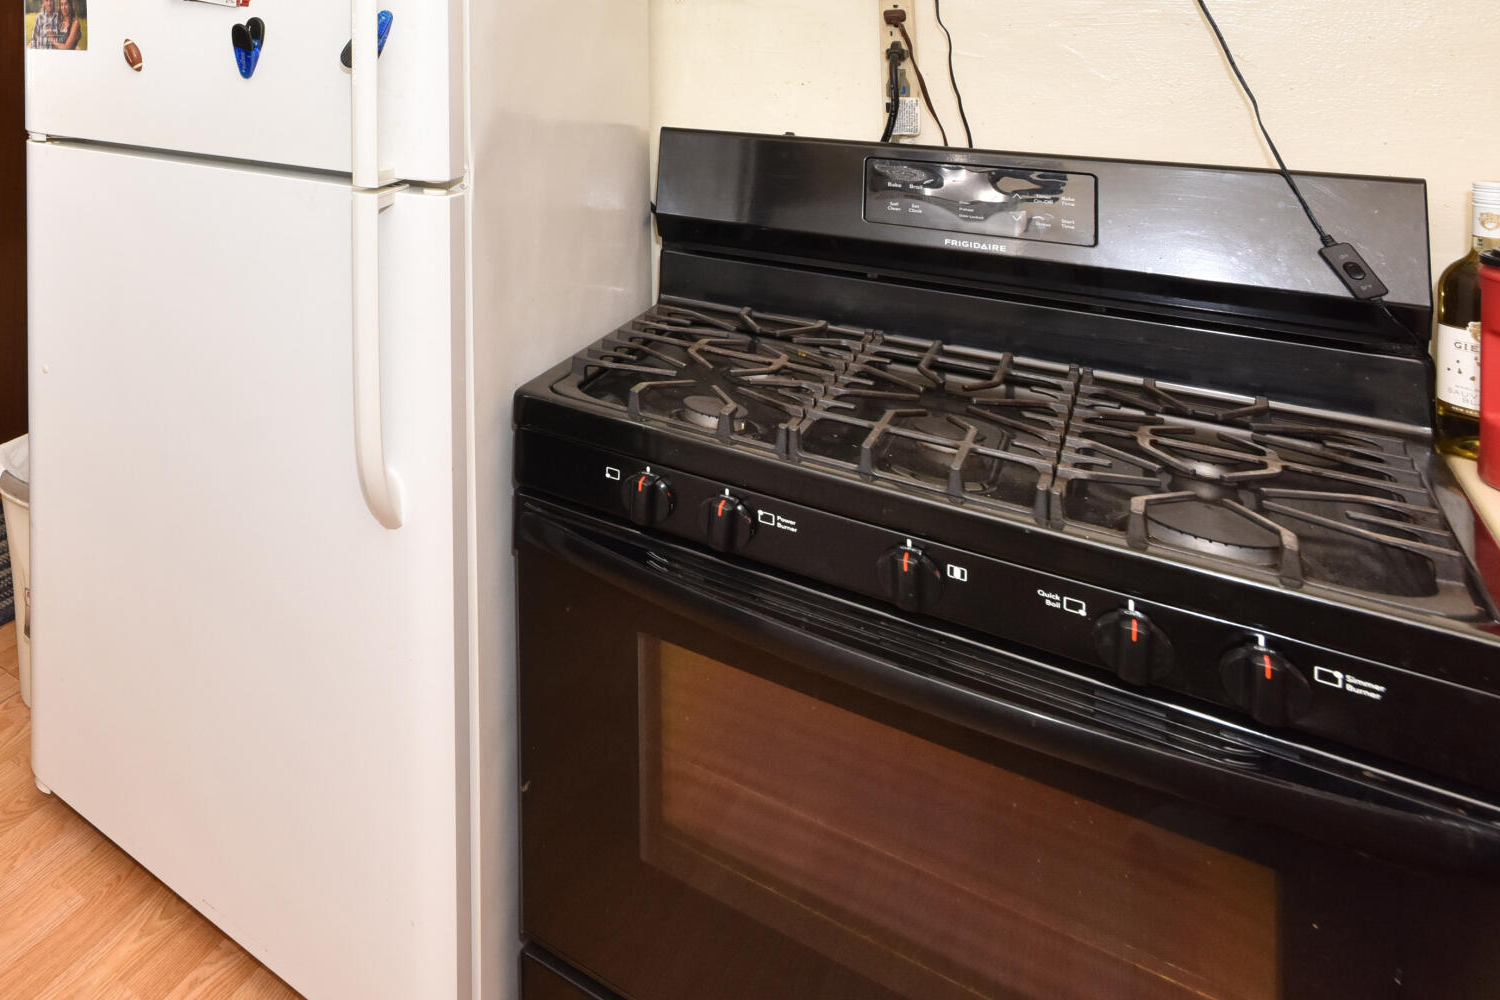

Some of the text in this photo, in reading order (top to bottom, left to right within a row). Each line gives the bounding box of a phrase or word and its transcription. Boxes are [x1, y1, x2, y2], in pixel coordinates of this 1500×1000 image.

[944, 238, 1007, 253] FRIGIDAIRE
[1453, 341, 1480, 353] GIE
[776, 515, 796, 526] Power
[776, 522, 798, 533] Burner
[1037, 589, 1061, 601] Quick
[1045, 599, 1061, 609] Boil
[1345, 674, 1388, 693] Simmer
[1345, 683, 1383, 701] Burner
